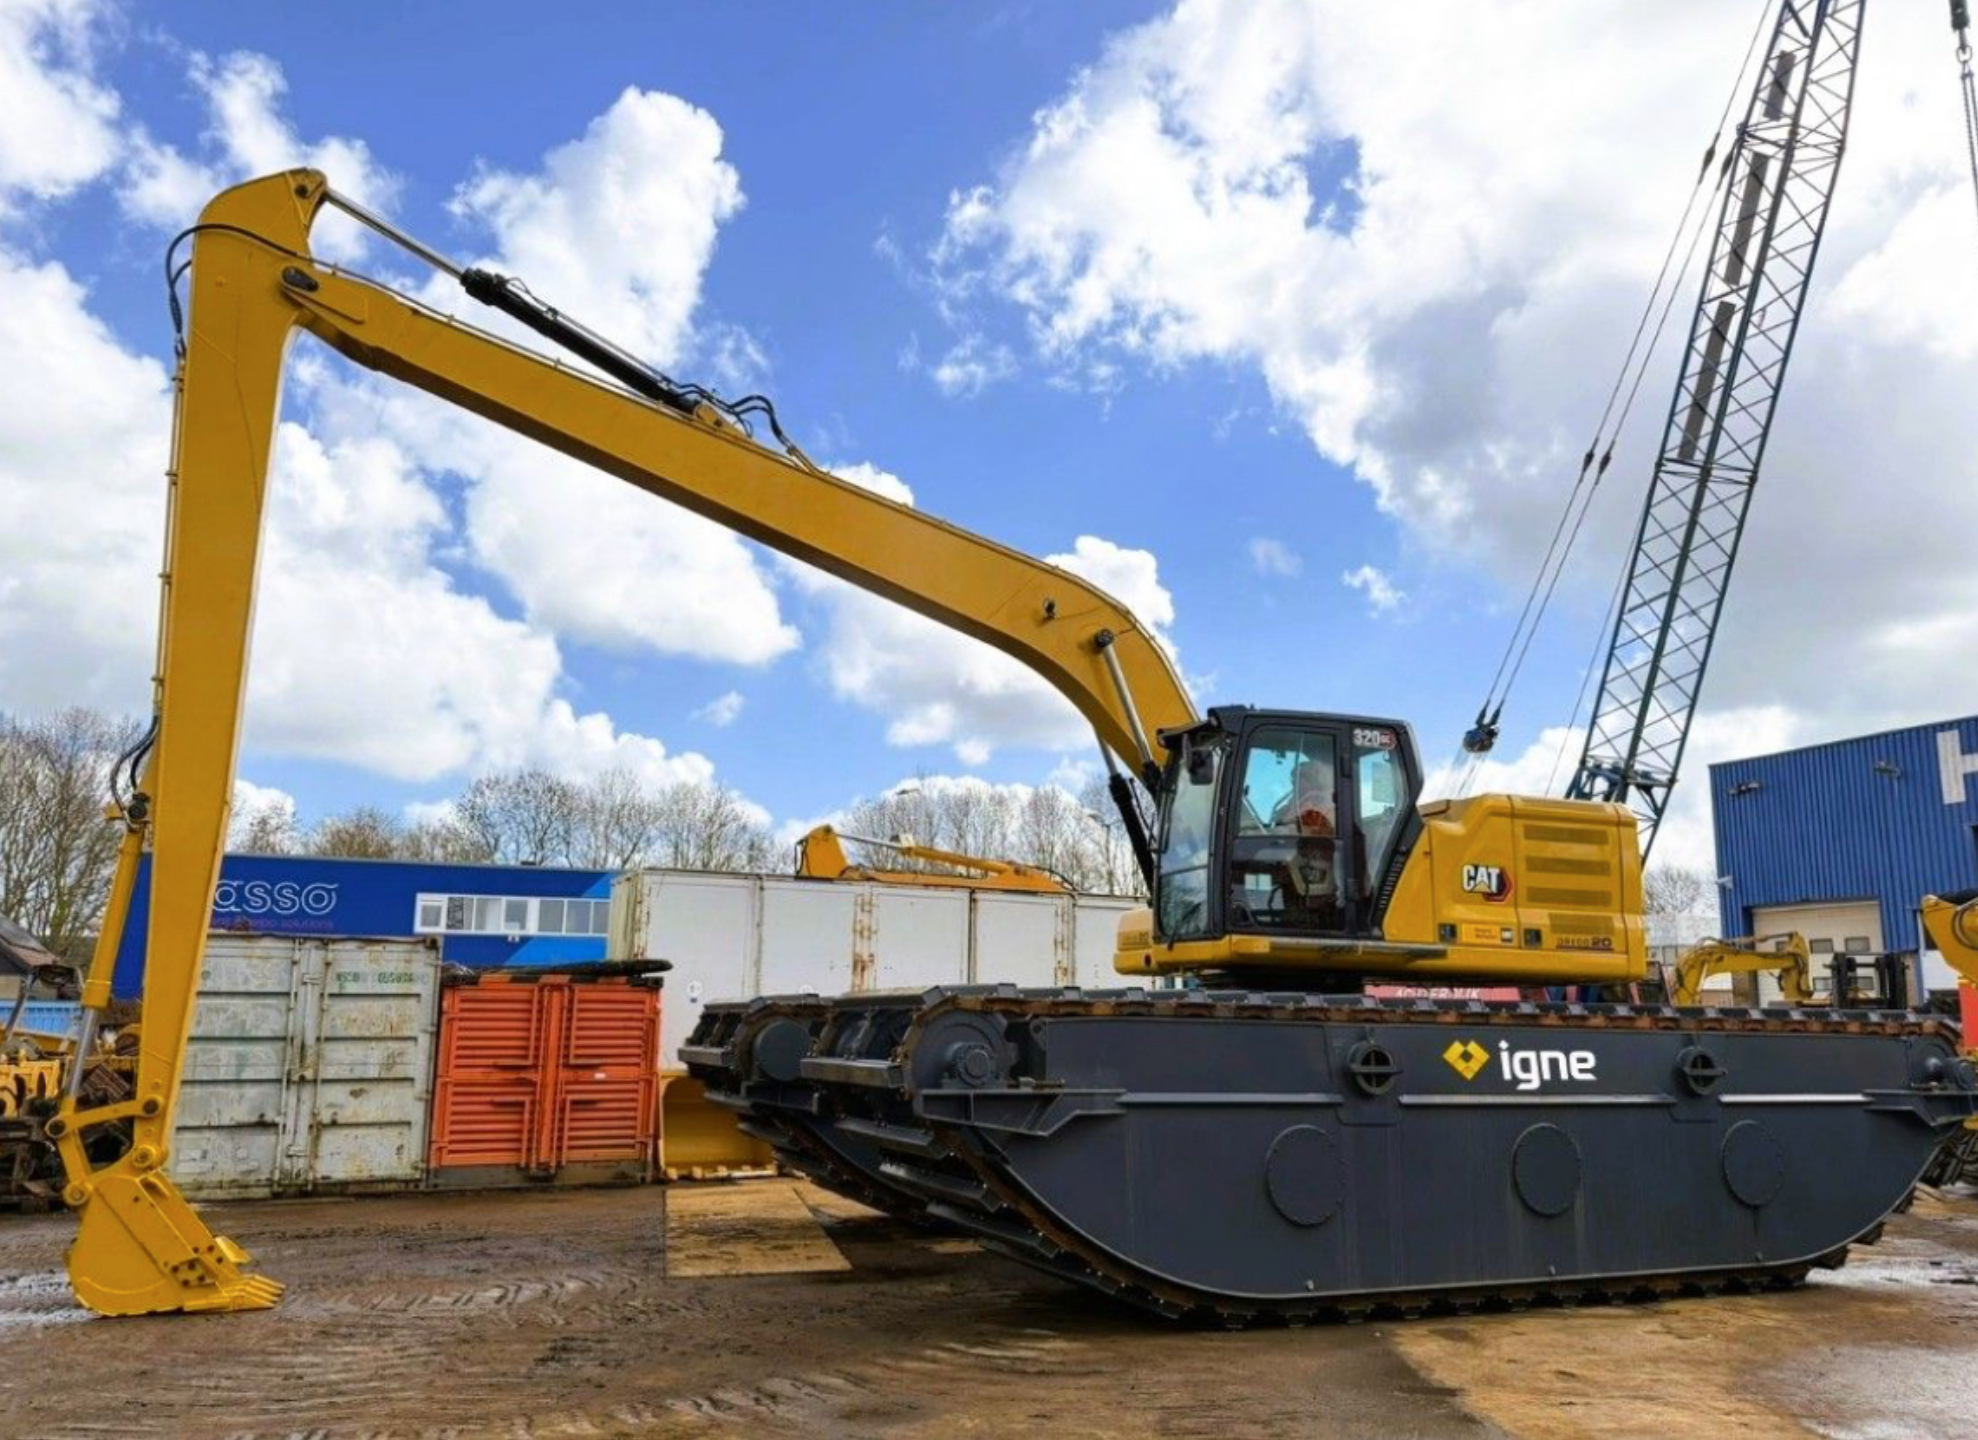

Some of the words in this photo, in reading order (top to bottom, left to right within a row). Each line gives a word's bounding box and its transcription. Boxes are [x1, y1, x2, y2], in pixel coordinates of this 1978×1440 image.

[1353, 728, 1380, 748] 320
[1462, 864, 1500, 893] CAT
[212, 880, 339, 915] asso
[1498, 1040, 1597, 1091] igne
